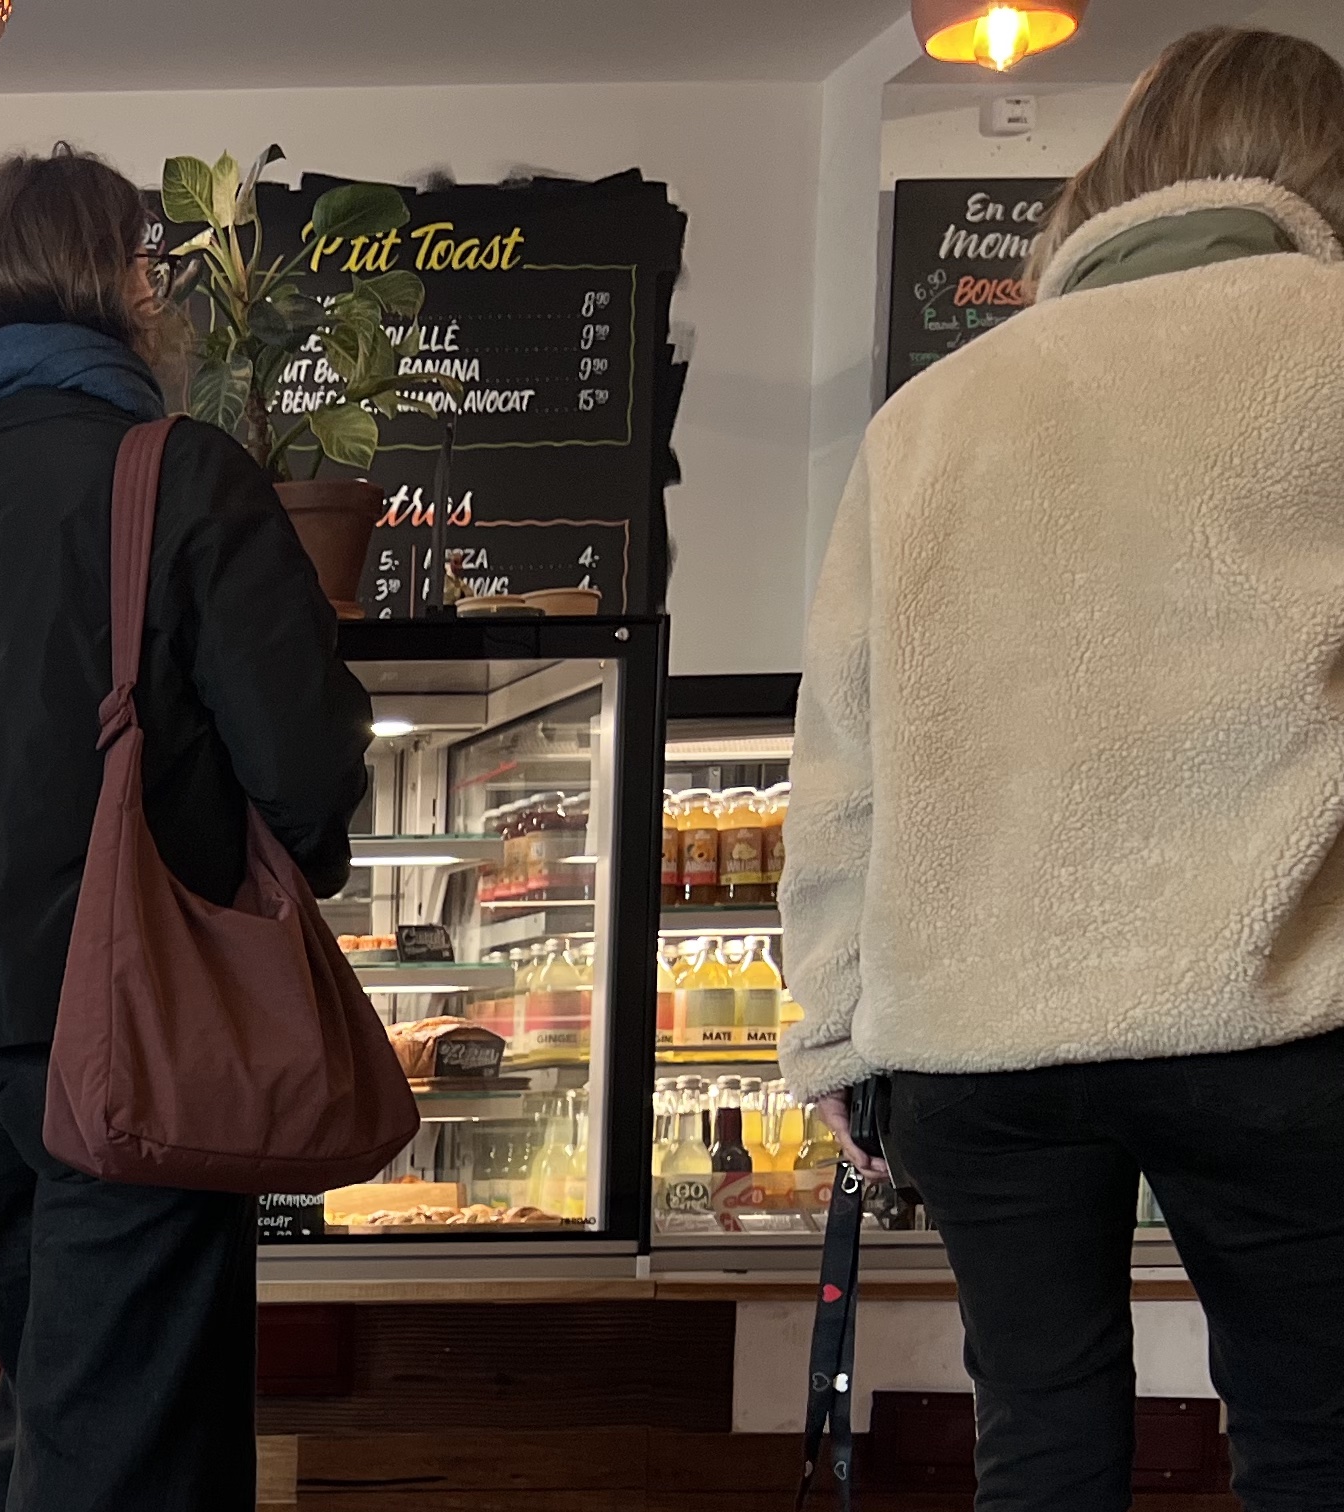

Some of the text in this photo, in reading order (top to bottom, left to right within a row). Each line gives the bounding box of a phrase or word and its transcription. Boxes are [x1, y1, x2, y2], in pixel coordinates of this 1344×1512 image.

[966, 192, 1005, 223] En
[411, 221, 525, 272] Toast
[463, 388, 535, 413] AVOCAT
